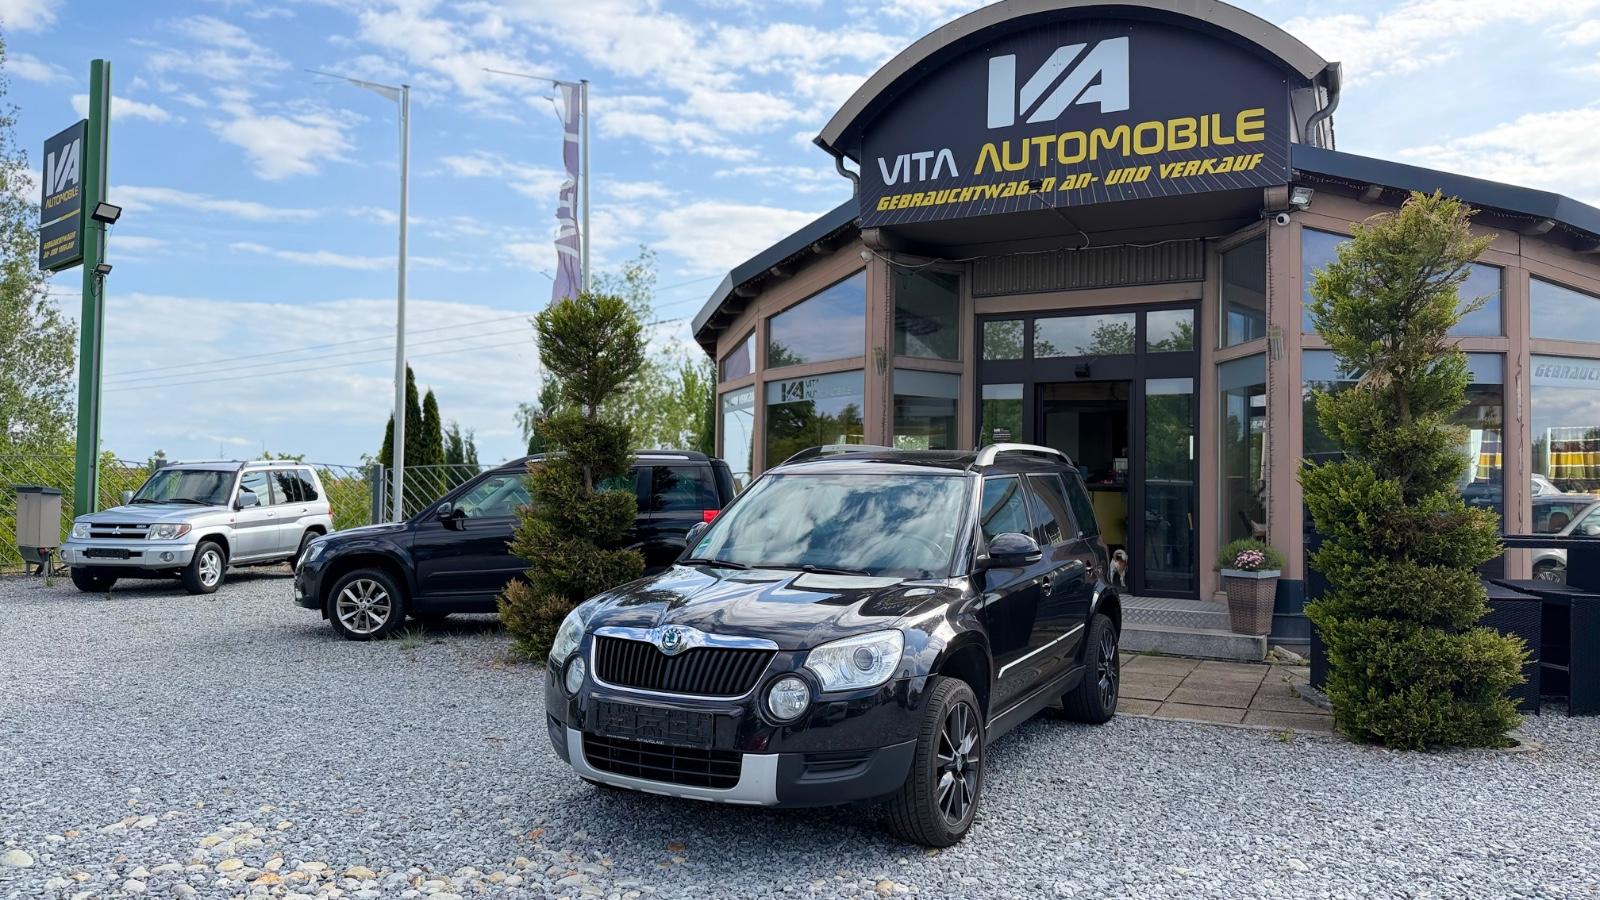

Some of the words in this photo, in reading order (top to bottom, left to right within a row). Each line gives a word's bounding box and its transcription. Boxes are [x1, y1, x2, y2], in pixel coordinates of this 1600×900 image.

[877, 148, 959, 186] VITA
[973, 107, 1265, 175] AUTOMOBILE
[45, 186, 79, 210] AUTOMOBILE
[876, 176, 1056, 211] GEBRAUCHTWAGN
[1159, 153, 1265, 179] VERKAUF
